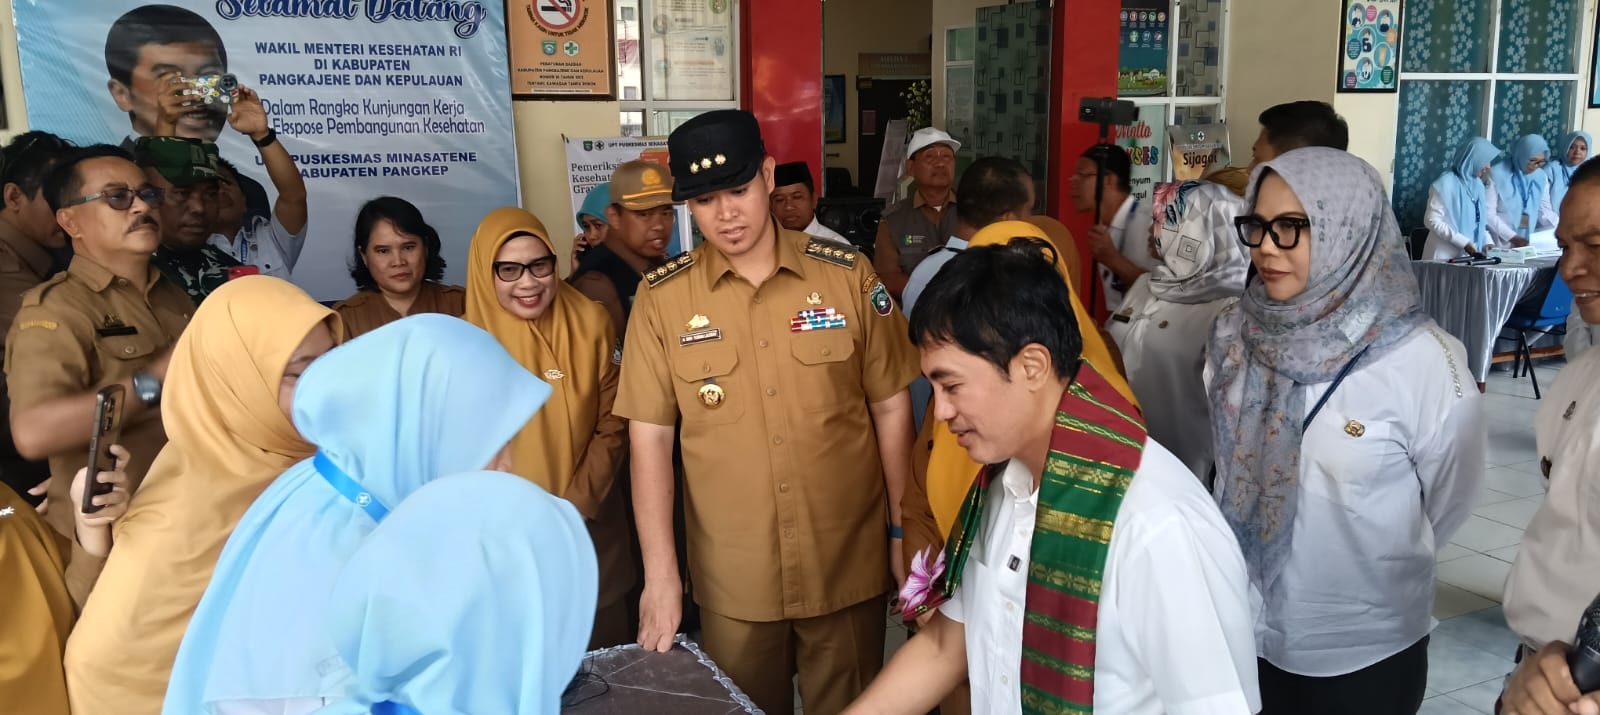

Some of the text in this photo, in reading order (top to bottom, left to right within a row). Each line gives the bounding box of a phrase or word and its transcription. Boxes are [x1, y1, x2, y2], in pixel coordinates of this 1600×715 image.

[216, 0, 487, 39] Selamat Datang
[255, 42, 462, 57] WAKIL MENTERI KESEHATAN RI
[314, 59, 410, 71] DI KABUPATEN
[259, 74, 463, 86] PANGKAJENE DAN KEPULAUAN
[261, 98, 465, 118] Dalam Rangka Kunjungan Kerja
[273, 117, 485, 138] Ekspose Pembangunan Kesehatan
[290, 152, 477, 165] PUSKESMAS MINASATENE
[300, 165, 449, 178] ABUPATEN PANGKEP
[571, 161, 617, 172] Pemeriks
[572, 173, 610, 183] Kesehat
[1130, 177, 1151, 186] nyum
[573, 185, 594, 194] Gra
